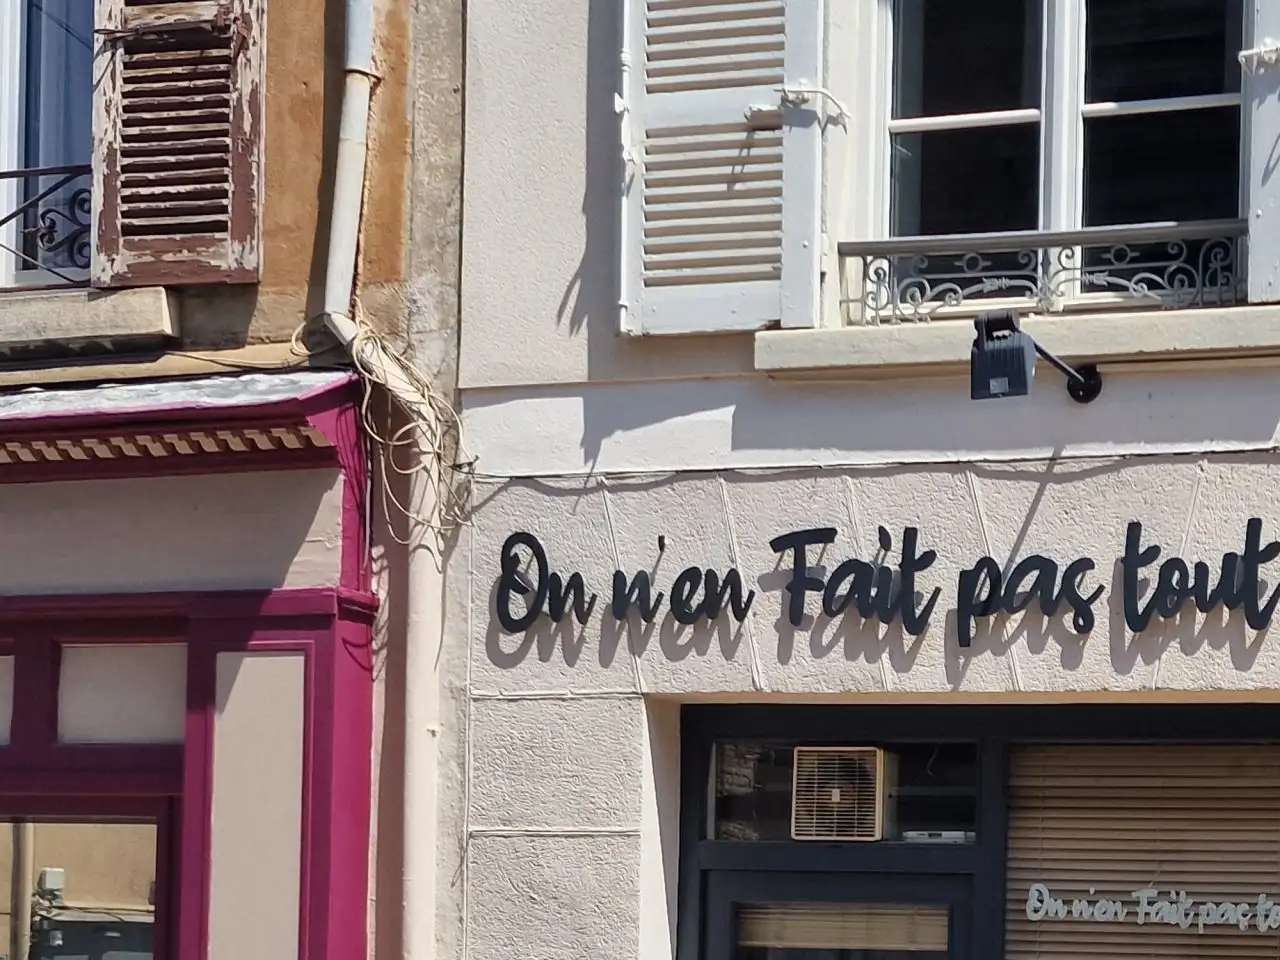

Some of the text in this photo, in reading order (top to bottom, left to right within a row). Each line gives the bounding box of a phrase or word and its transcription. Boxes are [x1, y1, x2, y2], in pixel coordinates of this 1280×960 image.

[499, 531, 597, 633] On
[612, 535, 755, 624] n'en
[769, 526, 941, 636] Fait
[957, 554, 1105, 648] pas
[1026, 883, 1067, 921] On
[1072, 887, 1127, 921] n'en
[1131, 888, 1193, 929] Fait
[1197, 901, 1253, 934] pas
